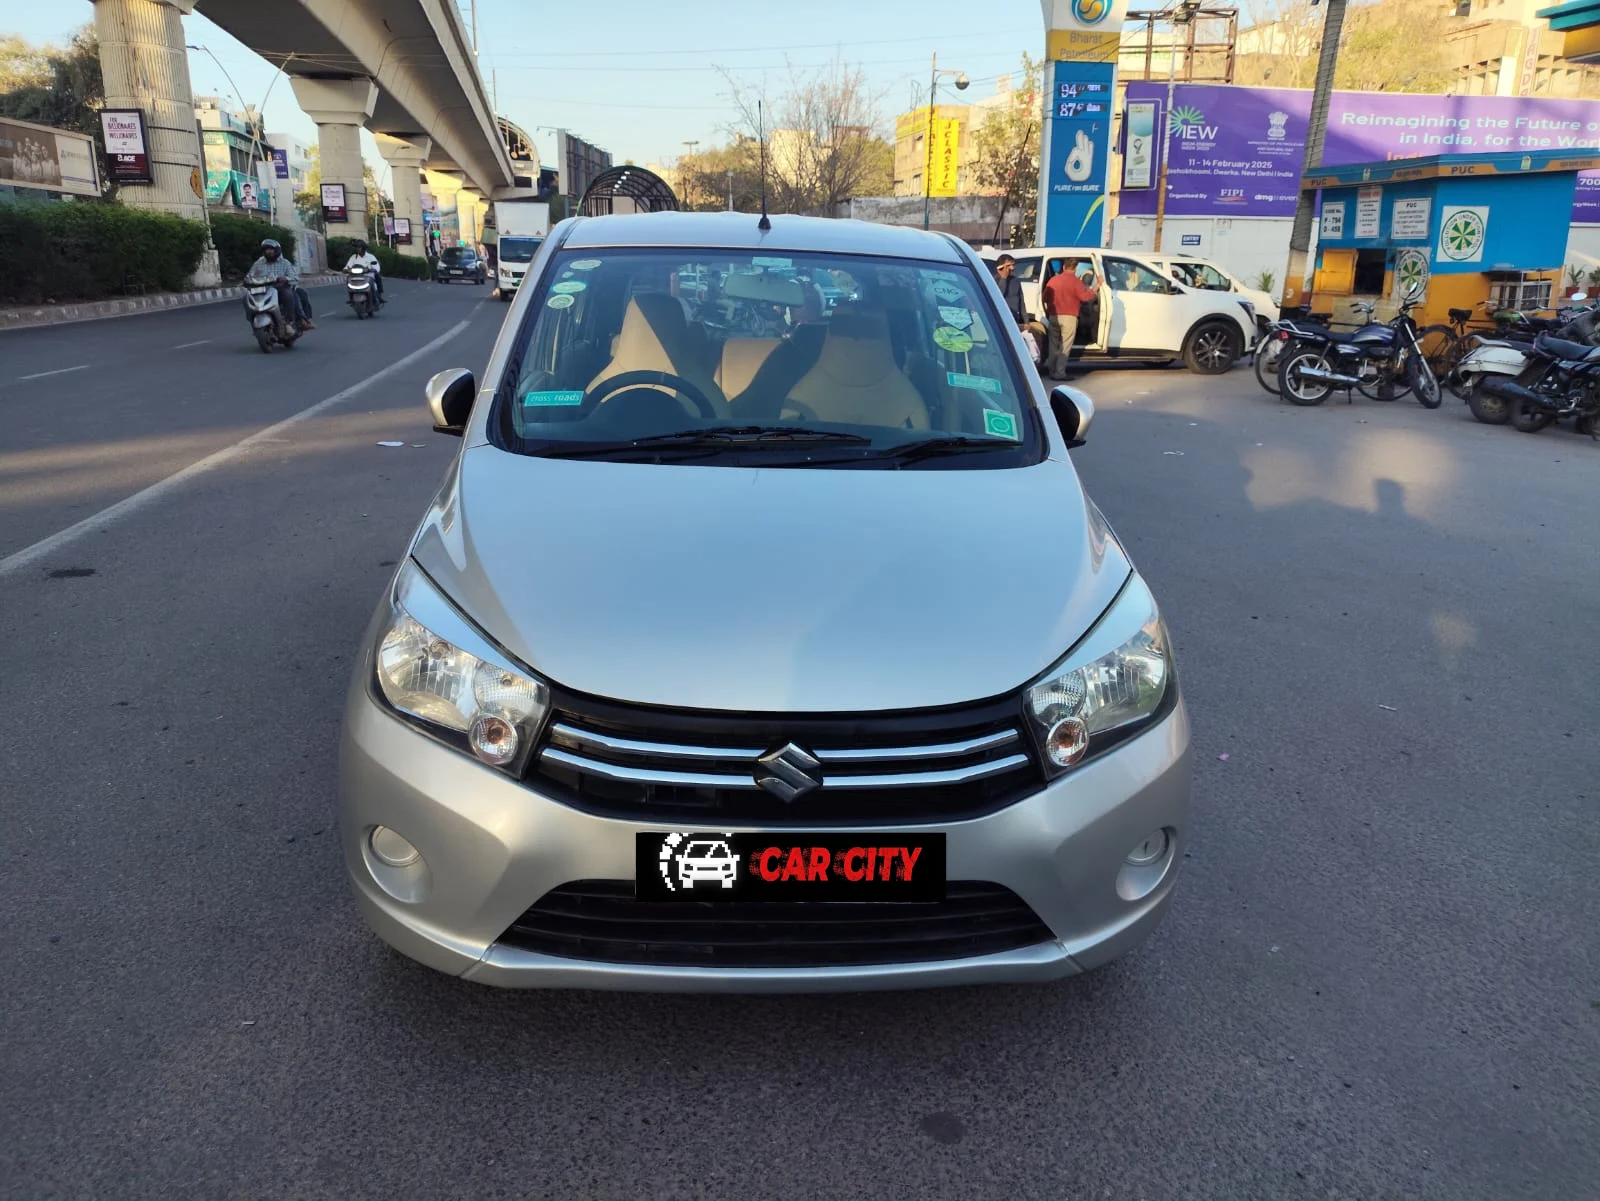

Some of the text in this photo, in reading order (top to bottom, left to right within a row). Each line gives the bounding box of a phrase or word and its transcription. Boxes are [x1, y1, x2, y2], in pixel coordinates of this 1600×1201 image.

[1070, 31, 1102, 43] Bharat
[1341, 112, 1600, 132] Reimagining the Future o
[1182, 125, 1218, 140] IEW
[1399, 132, 1600, 148] in India, for the Wor
[1212, 160, 1250, 169] February
[1251, 161, 1273, 169] 2025
[1451, 166, 1475, 175] PUC
[1311, 178, 1327, 186] PUC
[1220, 188, 1244, 197] FIPI
[934, 287, 959, 295] CNG
[553, 392, 580, 402] roads
